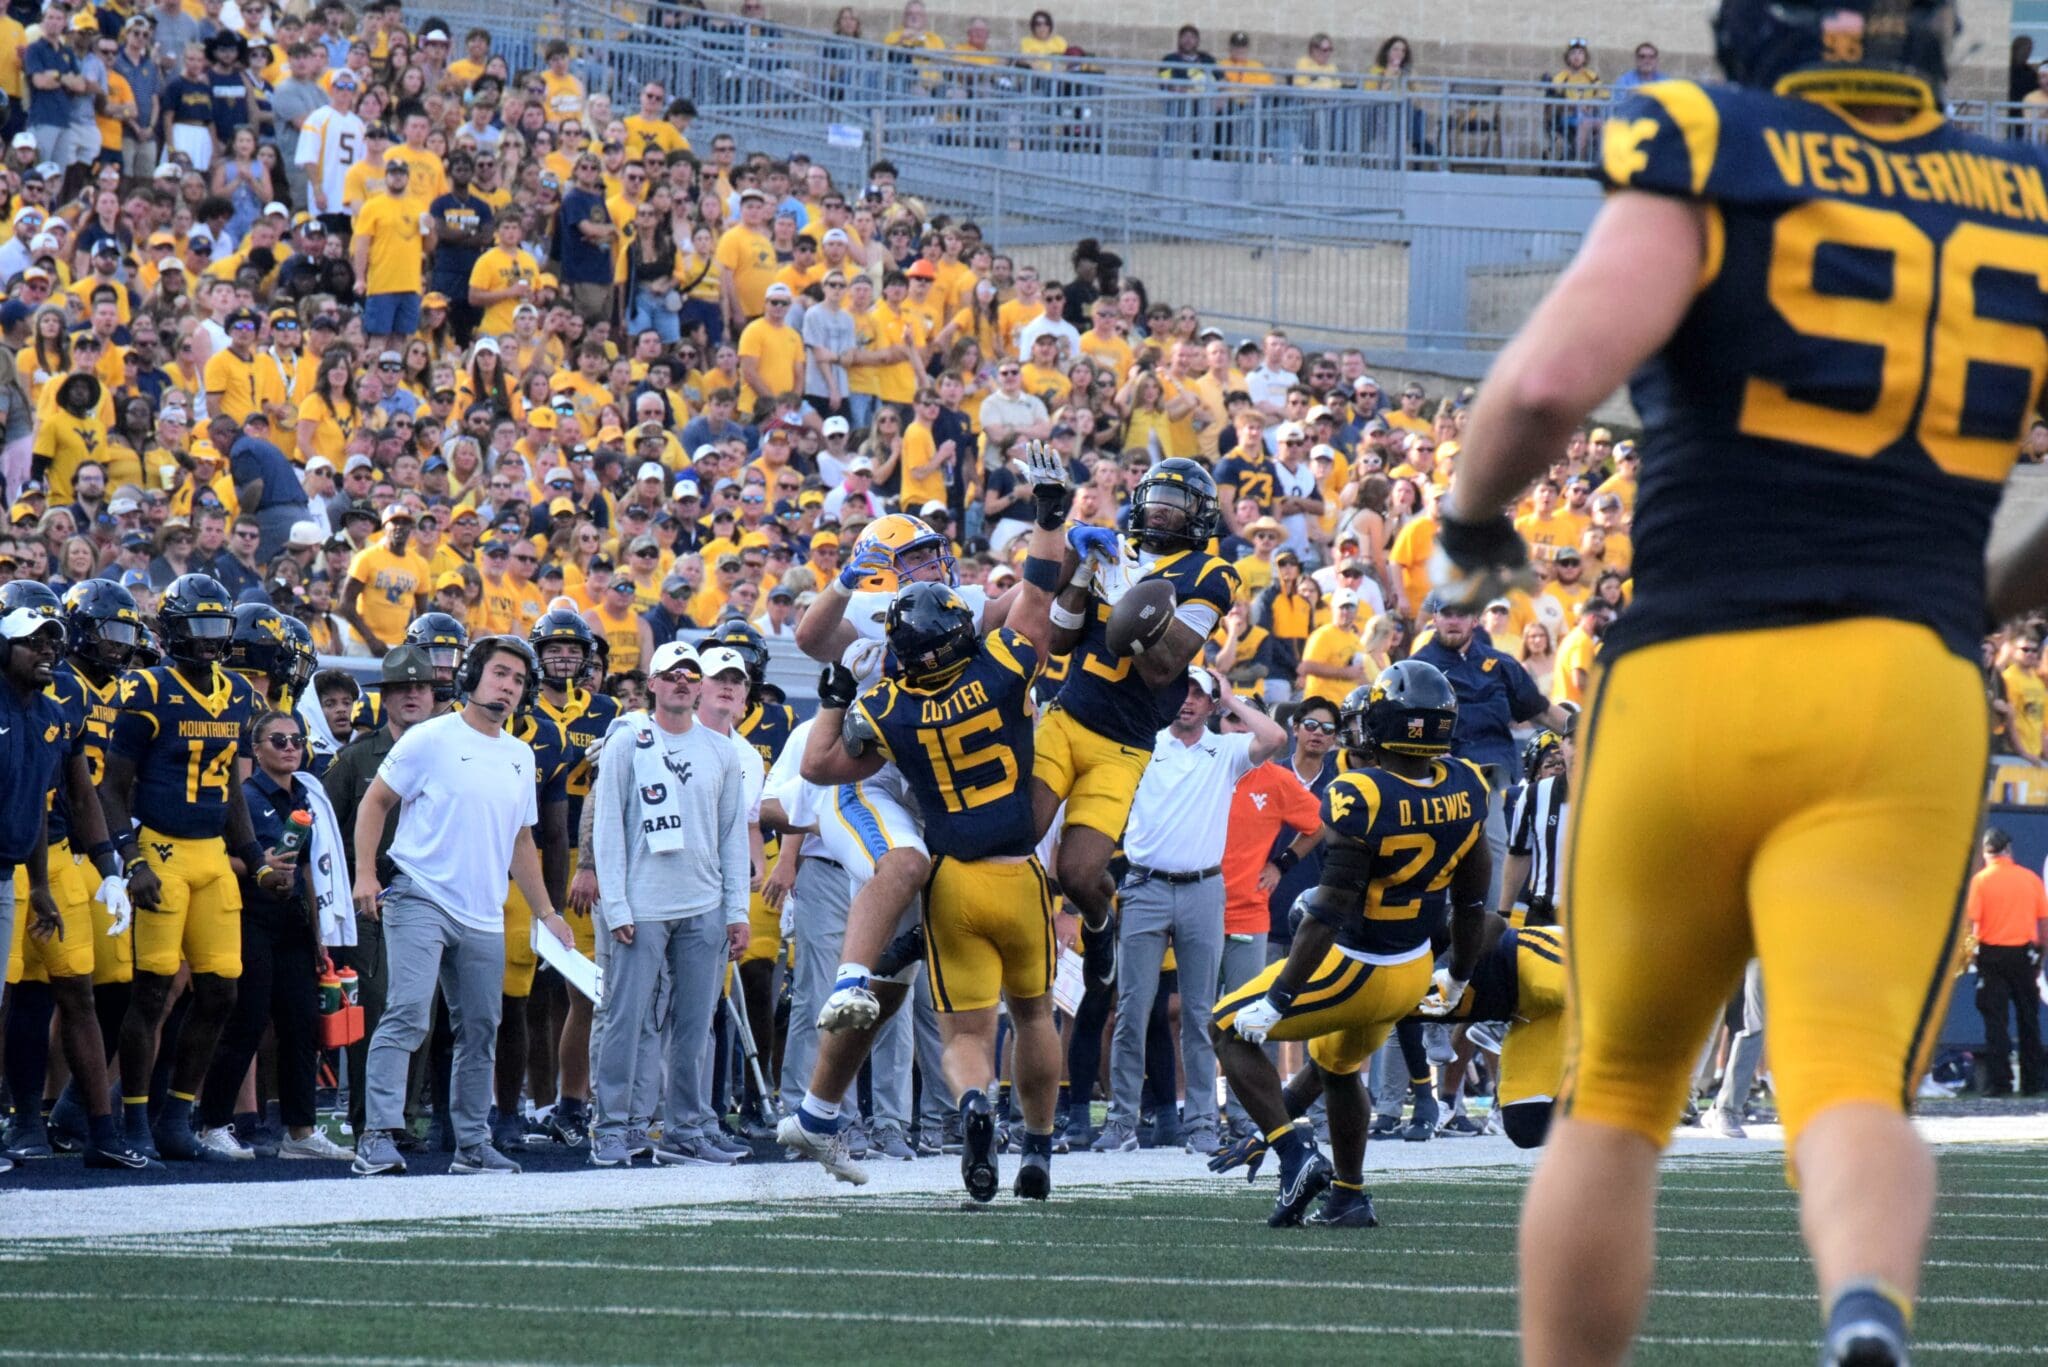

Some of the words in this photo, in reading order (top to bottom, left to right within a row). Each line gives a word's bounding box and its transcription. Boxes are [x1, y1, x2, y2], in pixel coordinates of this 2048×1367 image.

[340, 133, 355, 164] 5
[1763, 128, 2048, 224] VESTERINEN
[1738, 198, 2048, 483] 96
[921, 679, 990, 723] CUTTER
[1408, 727, 1423, 739] 24
[185, 739, 238, 803] 14
[916, 708, 1019, 813] 15
[1398, 798, 1417, 827] D.
[1422, 790, 1472, 825] LEWIS
[1548, 814, 1557, 826] S
[1362, 820, 1481, 921] 24
